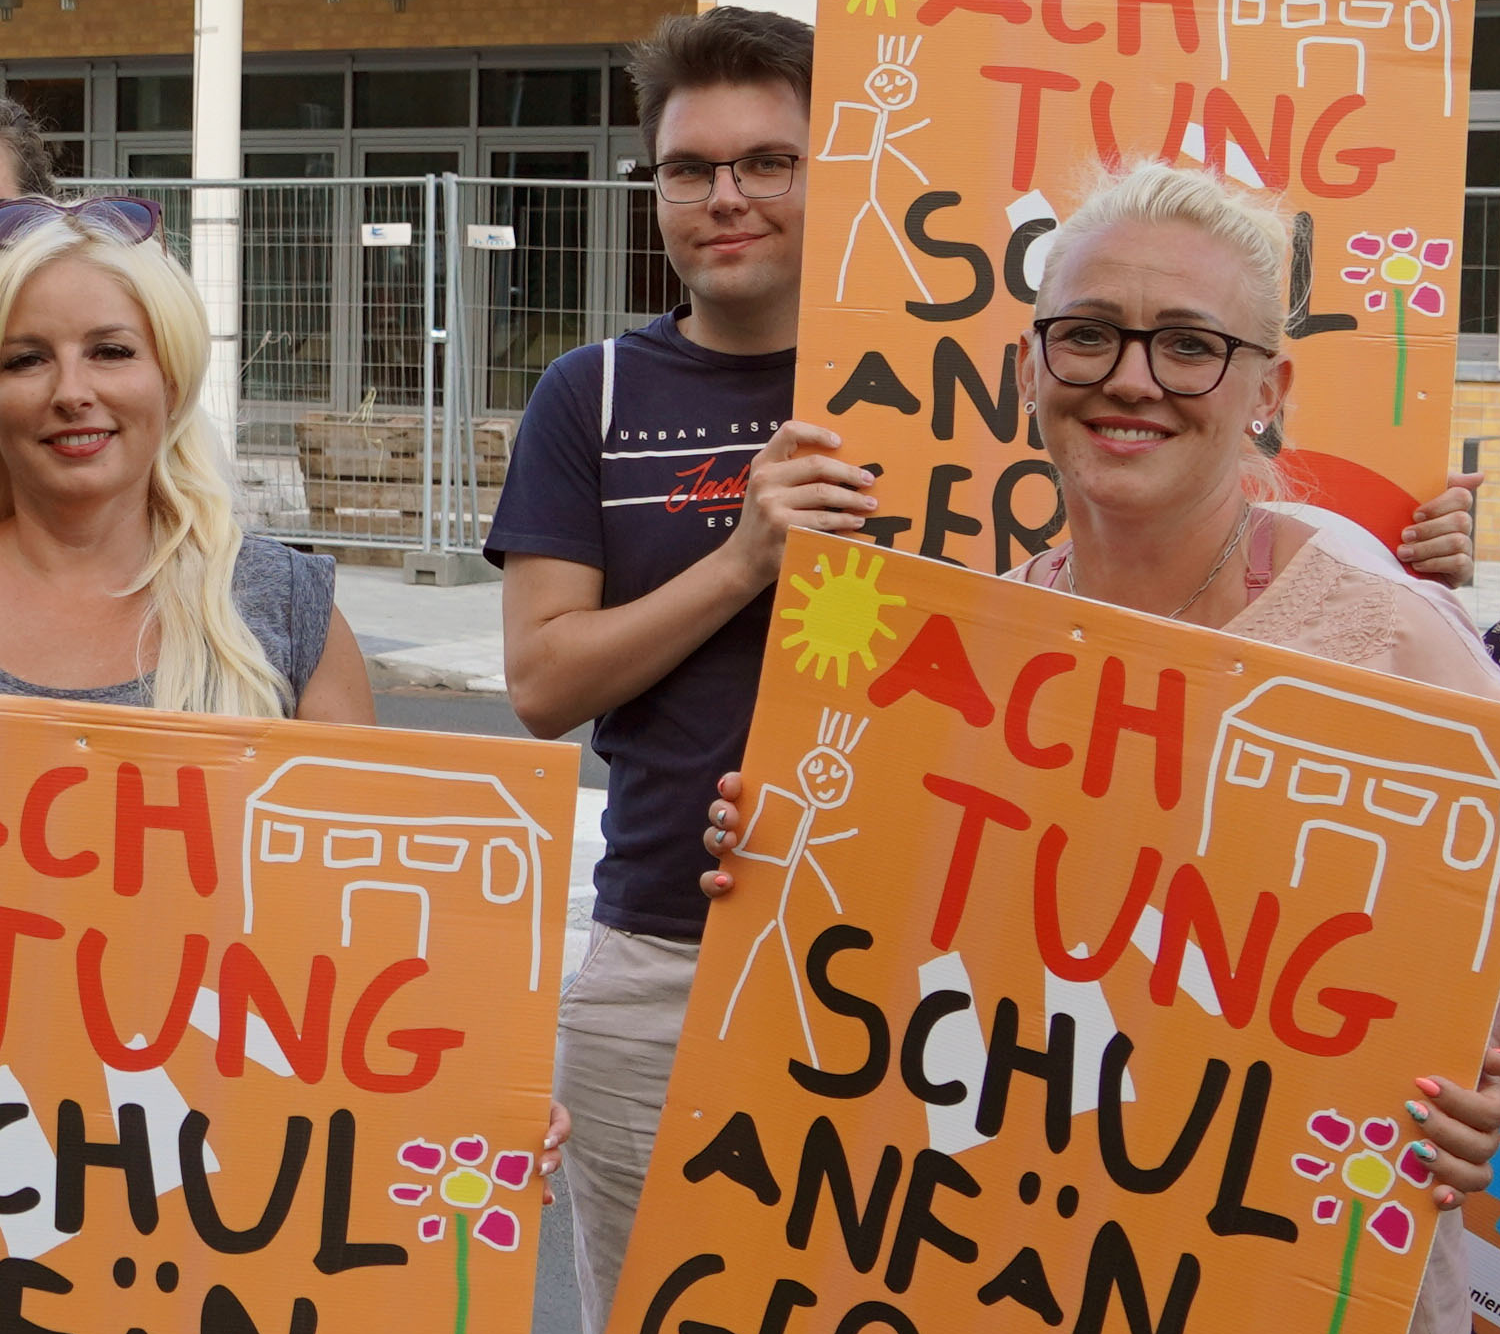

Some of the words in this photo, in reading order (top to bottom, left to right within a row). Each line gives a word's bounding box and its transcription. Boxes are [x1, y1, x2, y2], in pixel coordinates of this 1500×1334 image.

[980, 66, 1396, 198] TUNG
[904, 190, 1358, 340] SCL
[620, 427, 706, 440] URBAN
[731, 420, 778, 435] ESS
[707, 517, 733, 528] ES
[867, 612, 1187, 811] ACH
[923, 774, 1398, 1058] TUNG
[787, 922, 1298, 1243] SCHUL
